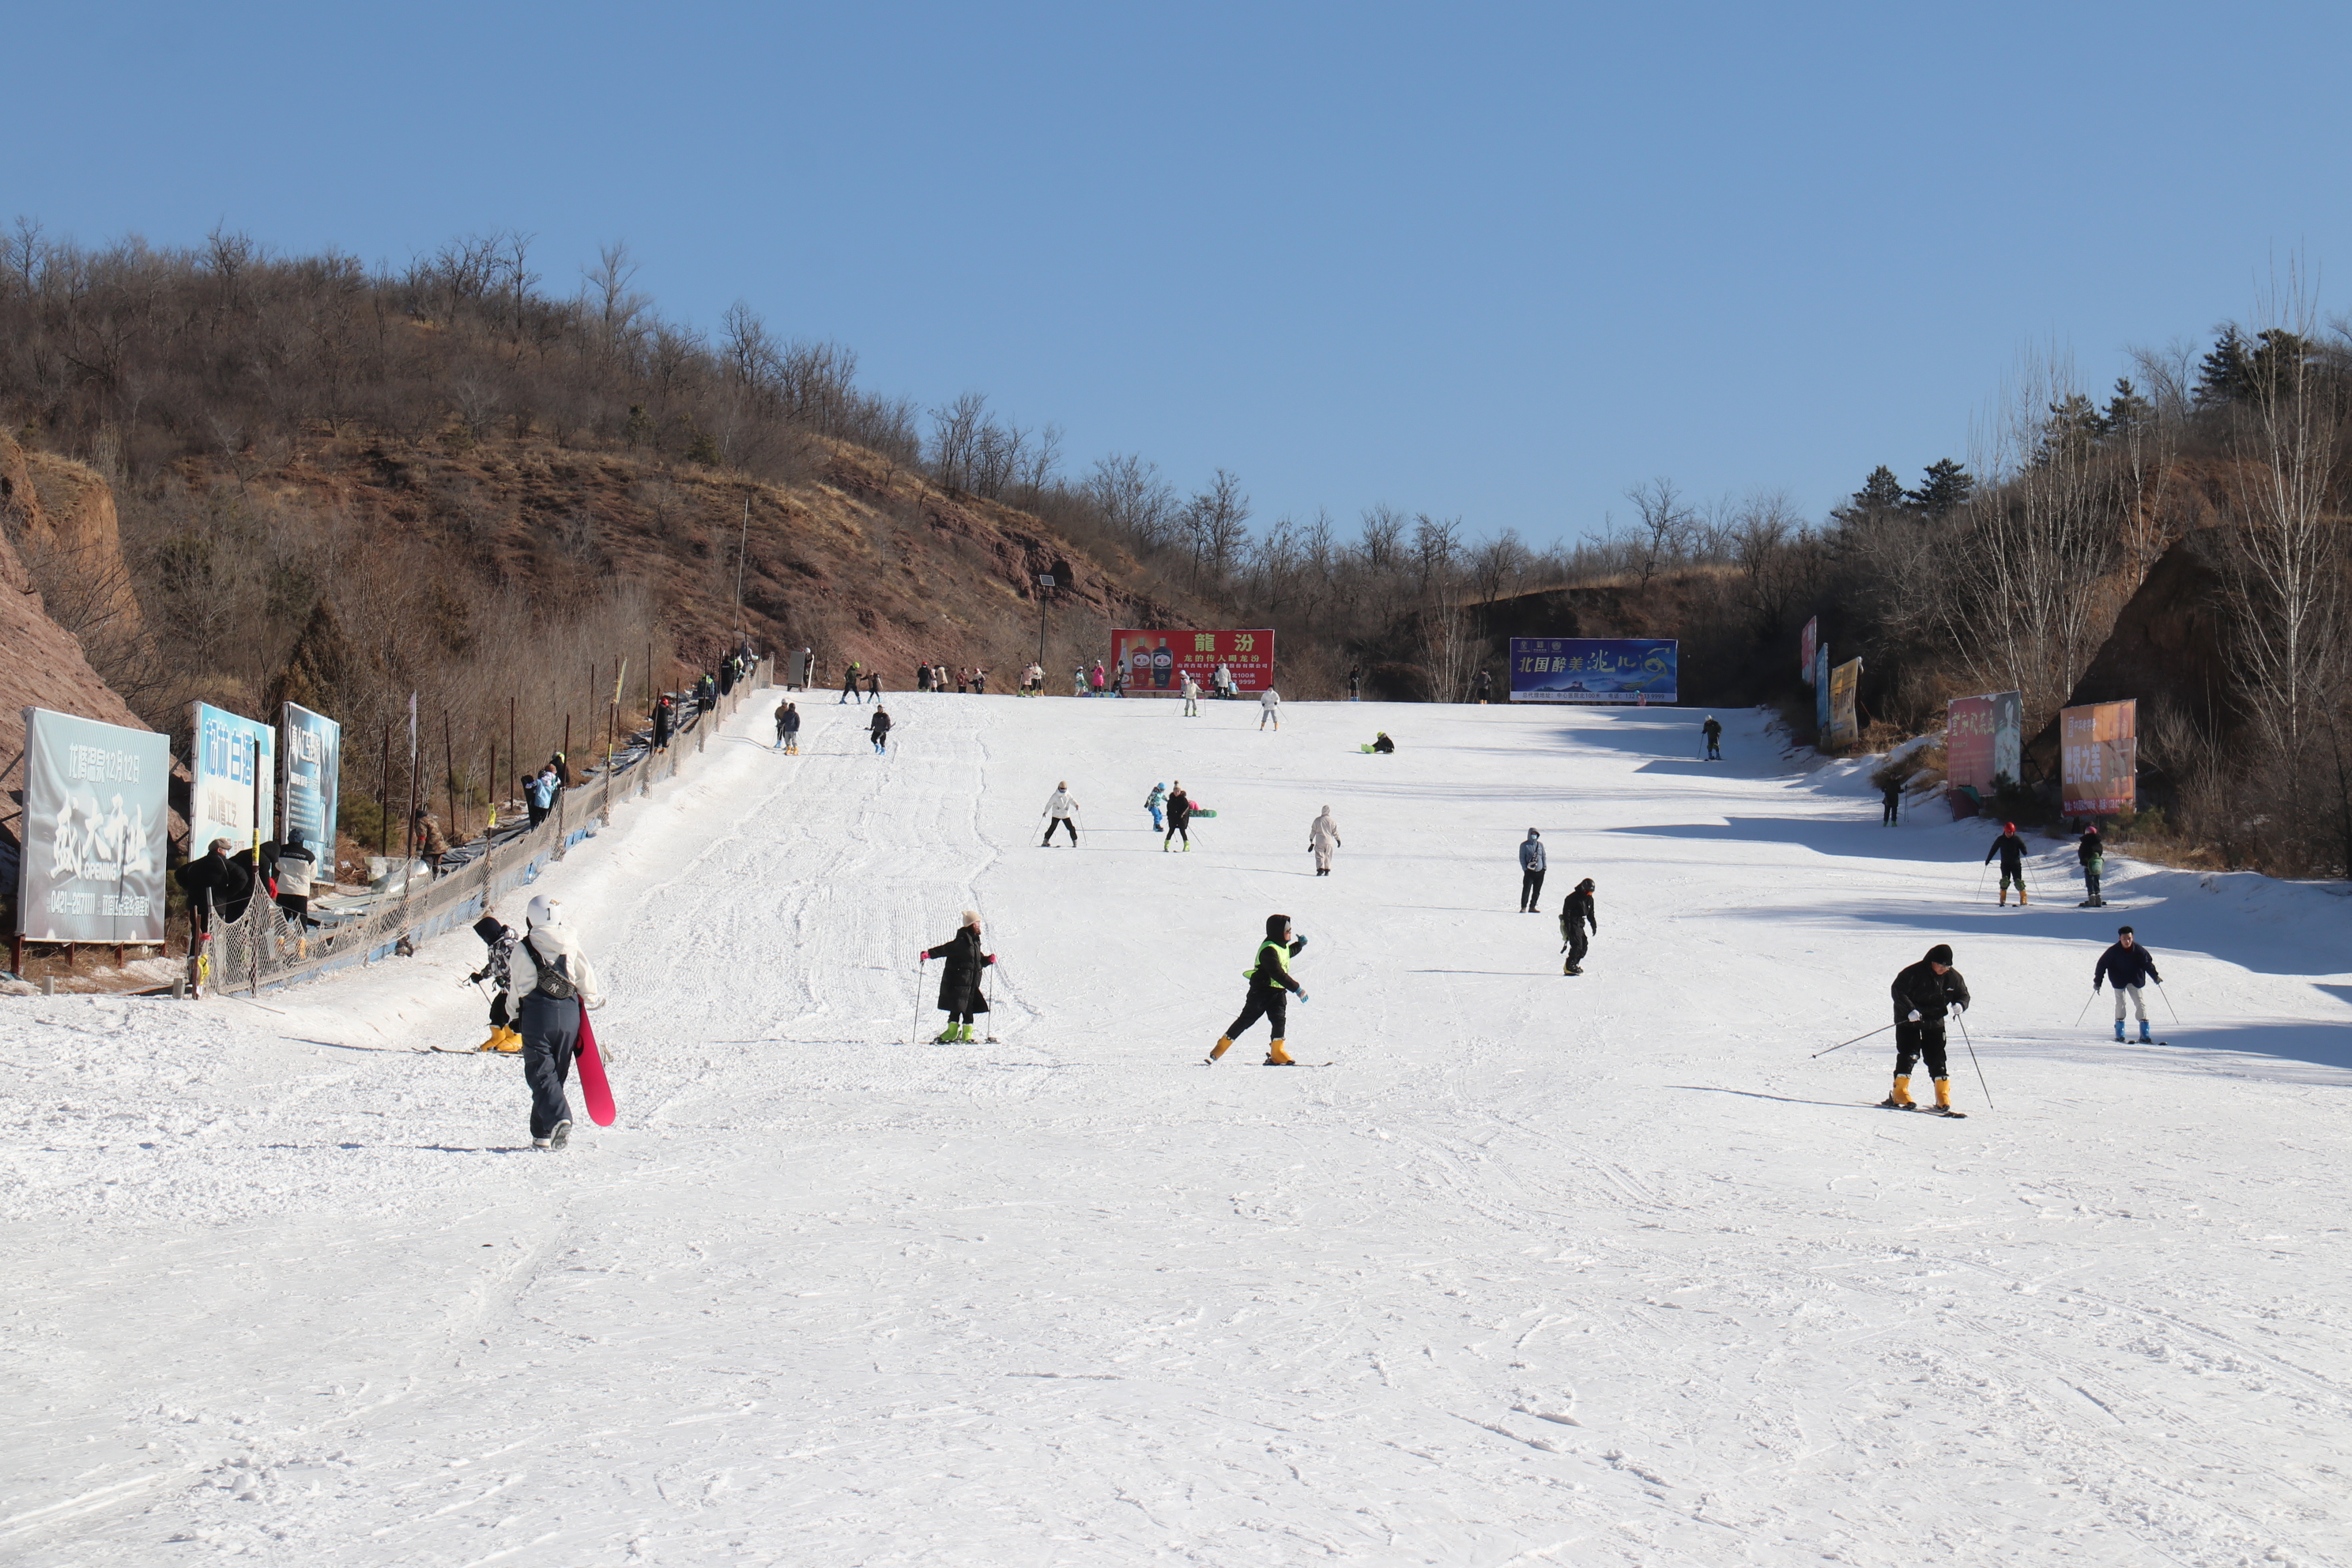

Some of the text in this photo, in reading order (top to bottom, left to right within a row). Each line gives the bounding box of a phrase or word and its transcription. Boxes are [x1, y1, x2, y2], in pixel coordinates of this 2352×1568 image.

[1194, 633, 1255, 652] 龍汾
[2064, 743, 2101, 784] 世界之美
[84, 862, 117, 881] OPENING
[546, 907, 551, 921] 1
[548, 983, 560, 993] NY
